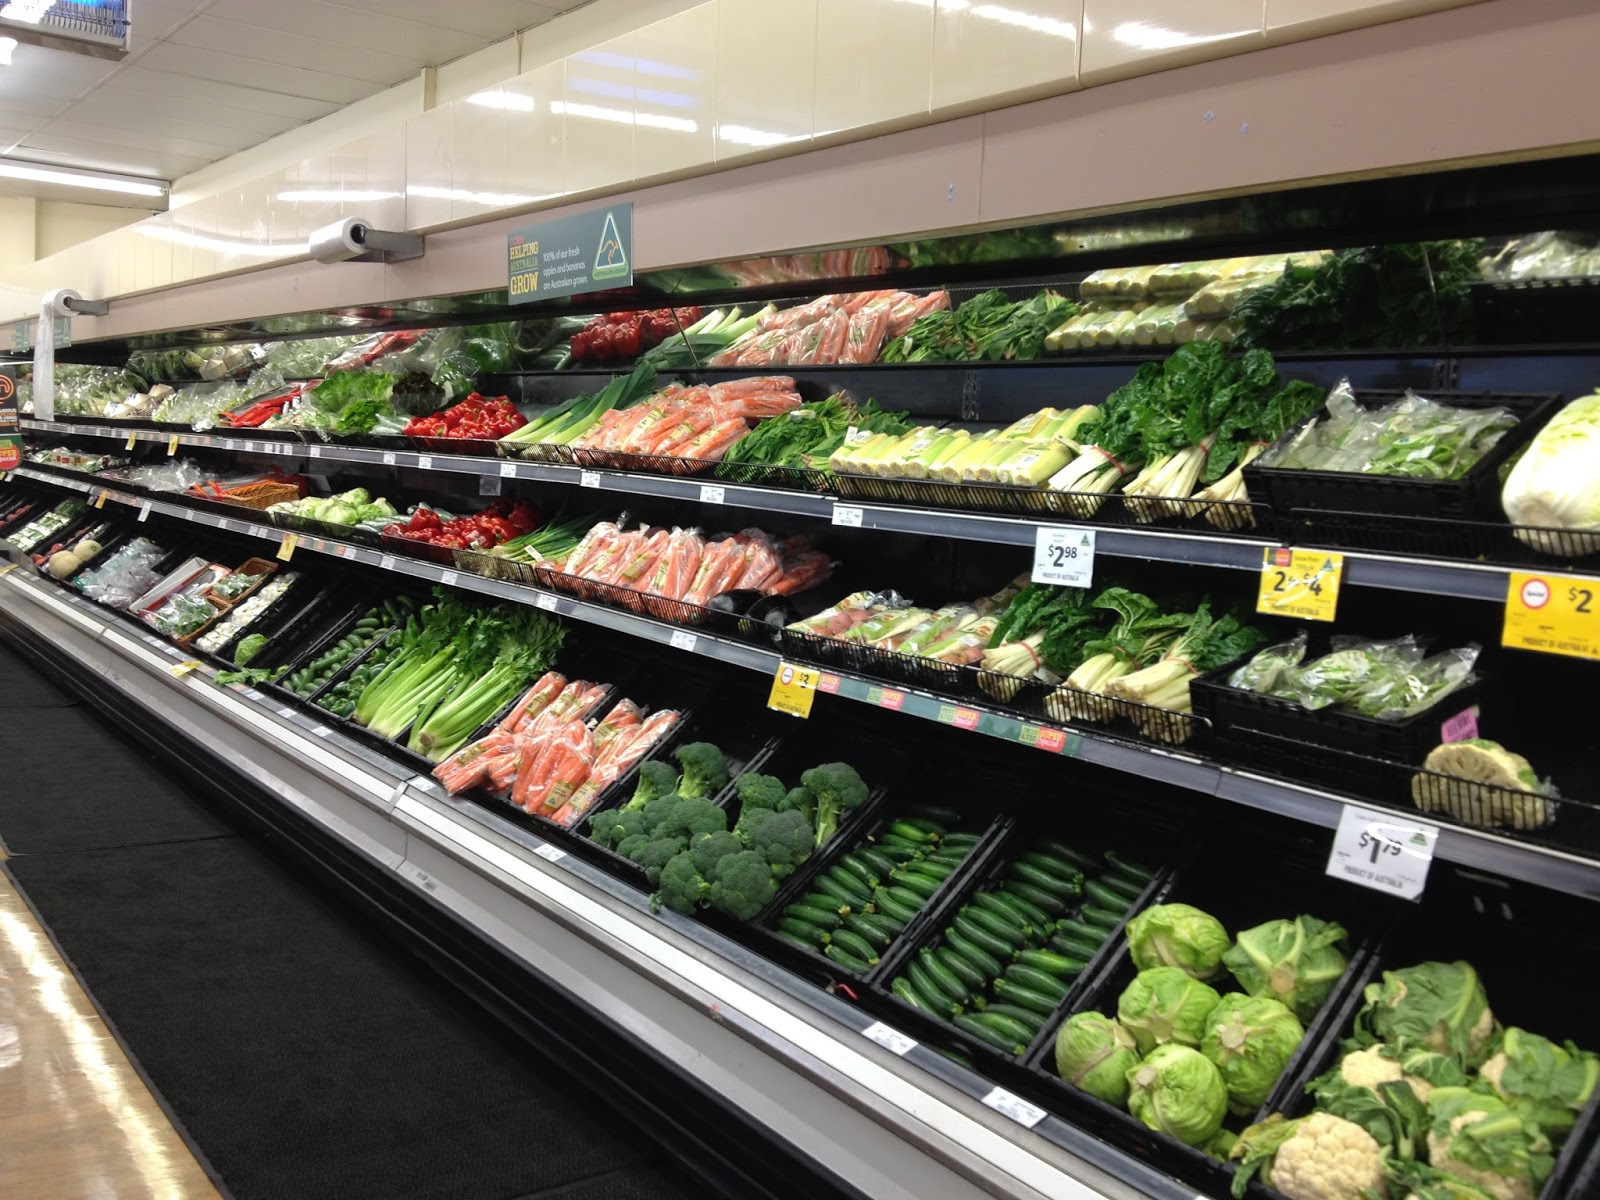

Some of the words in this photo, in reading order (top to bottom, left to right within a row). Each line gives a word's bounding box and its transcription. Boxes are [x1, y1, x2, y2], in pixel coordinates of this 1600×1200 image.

[510, 241, 538, 260] HELPING
[568, 246, 580, 258] fresh
[510, 272, 539, 295] GROW
[1274, 571, 1286, 592] 2
